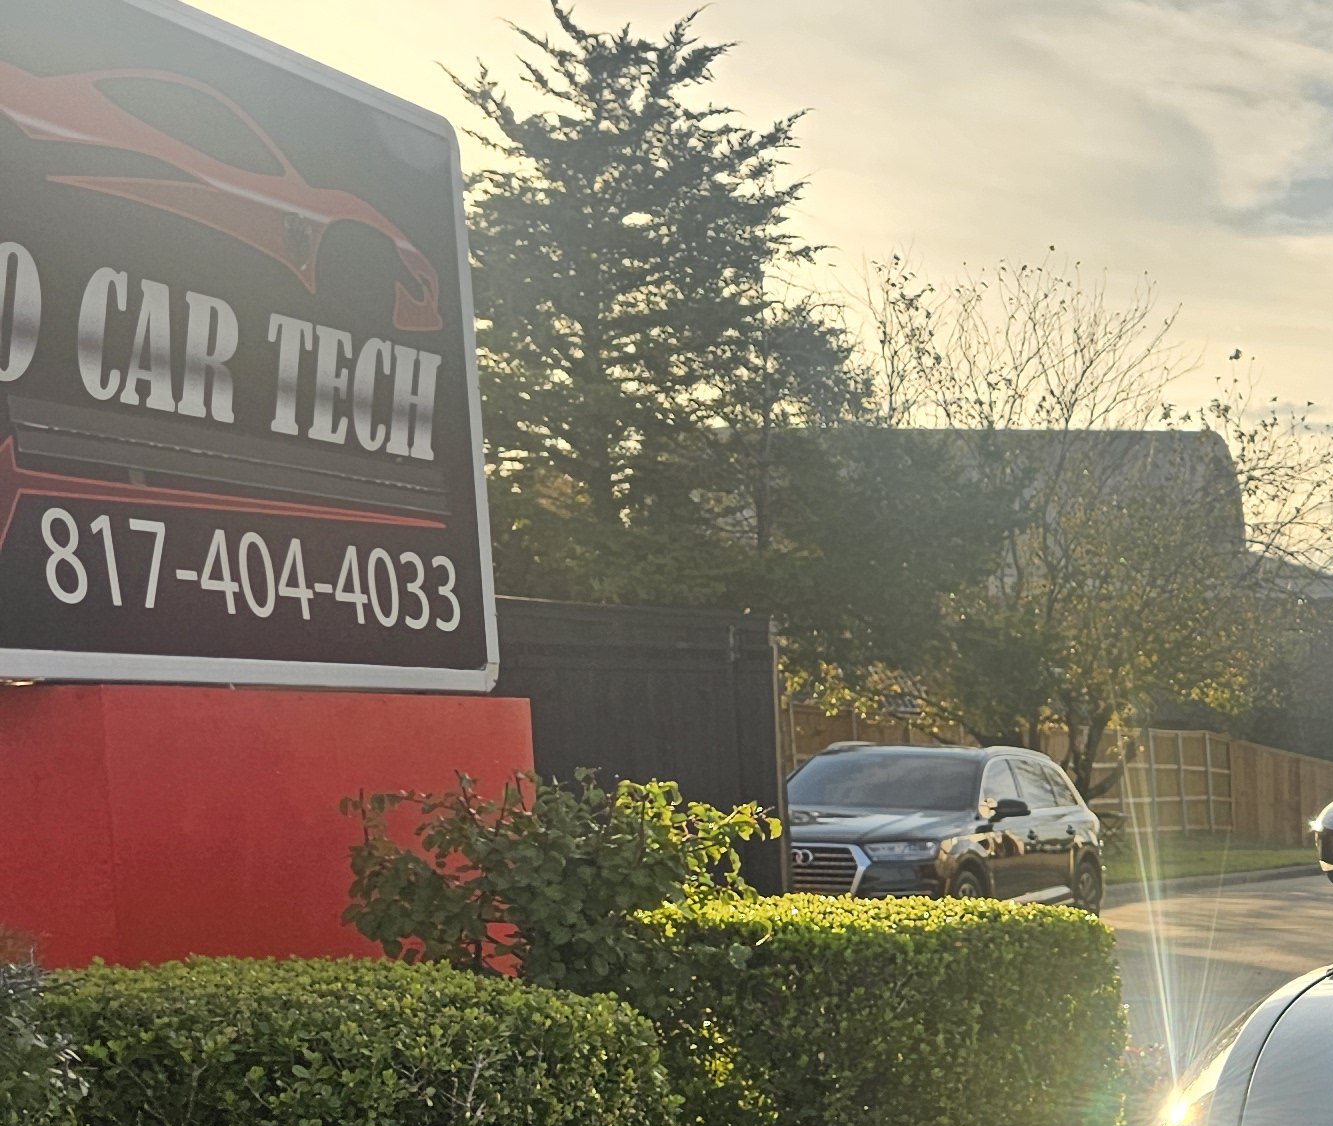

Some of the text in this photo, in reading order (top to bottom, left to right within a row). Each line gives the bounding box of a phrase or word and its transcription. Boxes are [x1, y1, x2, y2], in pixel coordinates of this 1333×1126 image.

[77, 266, 239, 423] CAR
[267, 312, 442, 461] TECH
[41, 507, 461, 632] 817-404-4033
